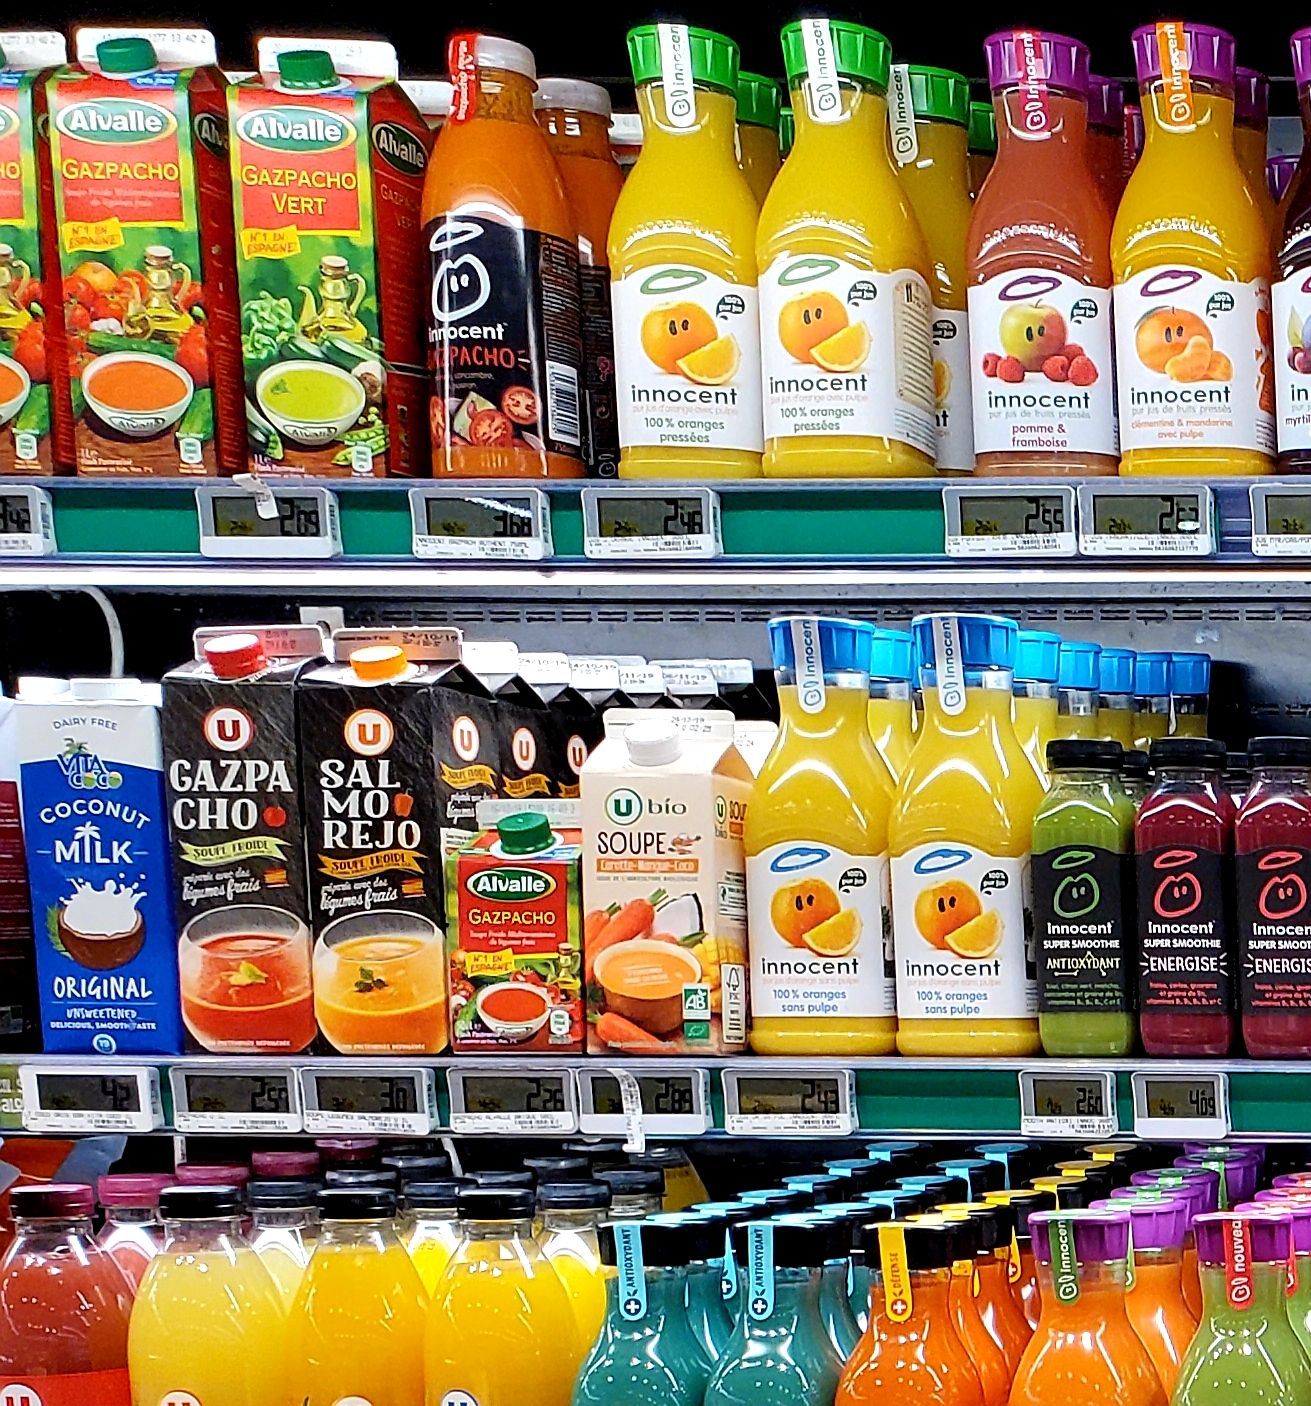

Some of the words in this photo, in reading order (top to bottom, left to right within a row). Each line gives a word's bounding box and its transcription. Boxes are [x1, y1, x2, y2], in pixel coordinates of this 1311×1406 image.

[70, 109, 163, 134] Alvalle
[61, 158, 180, 182] GAZPACHO
[272, 194, 327, 217] VERT
[630, 384, 738, 407] innocent
[988, 390, 1090, 410] innocent
[677, 419, 725, 432] oranges
[1012, 425, 1052, 437] pomme
[1056, 424, 1066, 435] &
[1011, 436, 1068, 448] framboise
[52, 717, 87, 731] DAIRY
[90, 717, 118, 730] FREE
[169, 760, 293, 794] GAZPA
[320, 760, 401, 788] SAL
[39, 801, 150, 829] COCONUT
[172, 799, 257, 831] CHO
[323, 791, 389, 817] MO
[54, 826, 133, 864] MILK
[323, 821, 421, 850] REJO
[597, 832, 666, 856] SOUPE
[182, 882, 225, 903] légumes
[228, 878, 260, 899] frais
[475, 874, 548, 895] Alvalle
[468, 909, 557, 926] GAZPACHO
[761, 957, 860, 977] innocent
[53, 977, 152, 1000] ORIGINAL
[66, 1008, 137, 1019] UNSWEETENED
[781, 1004, 806, 1014] sans
[808, 1002, 838, 1015] pulpe
